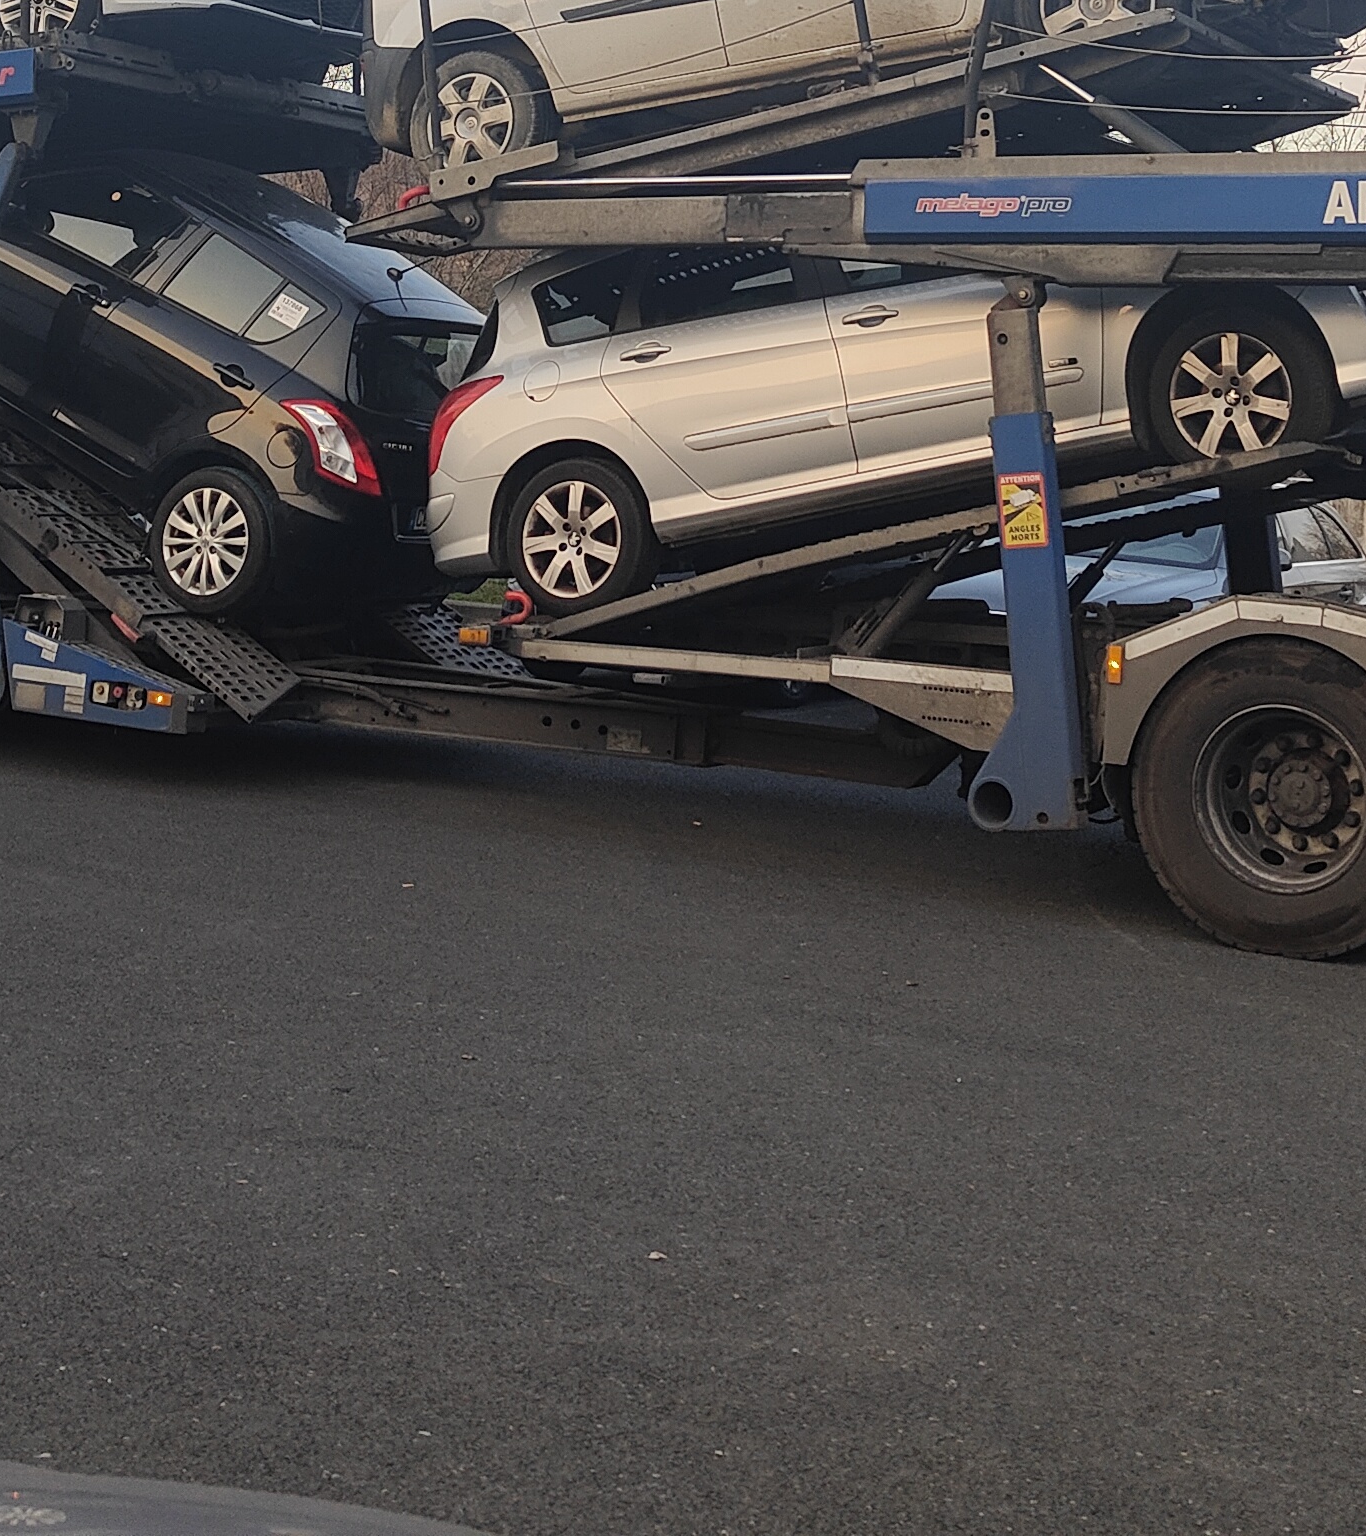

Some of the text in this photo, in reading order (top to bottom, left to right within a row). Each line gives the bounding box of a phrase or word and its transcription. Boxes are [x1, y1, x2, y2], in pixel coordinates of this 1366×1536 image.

[1000, 474, 1041, 484] ATTENTION
[1009, 524, 1041, 533] ANGLES
[1011, 533, 1040, 541] MORTS
